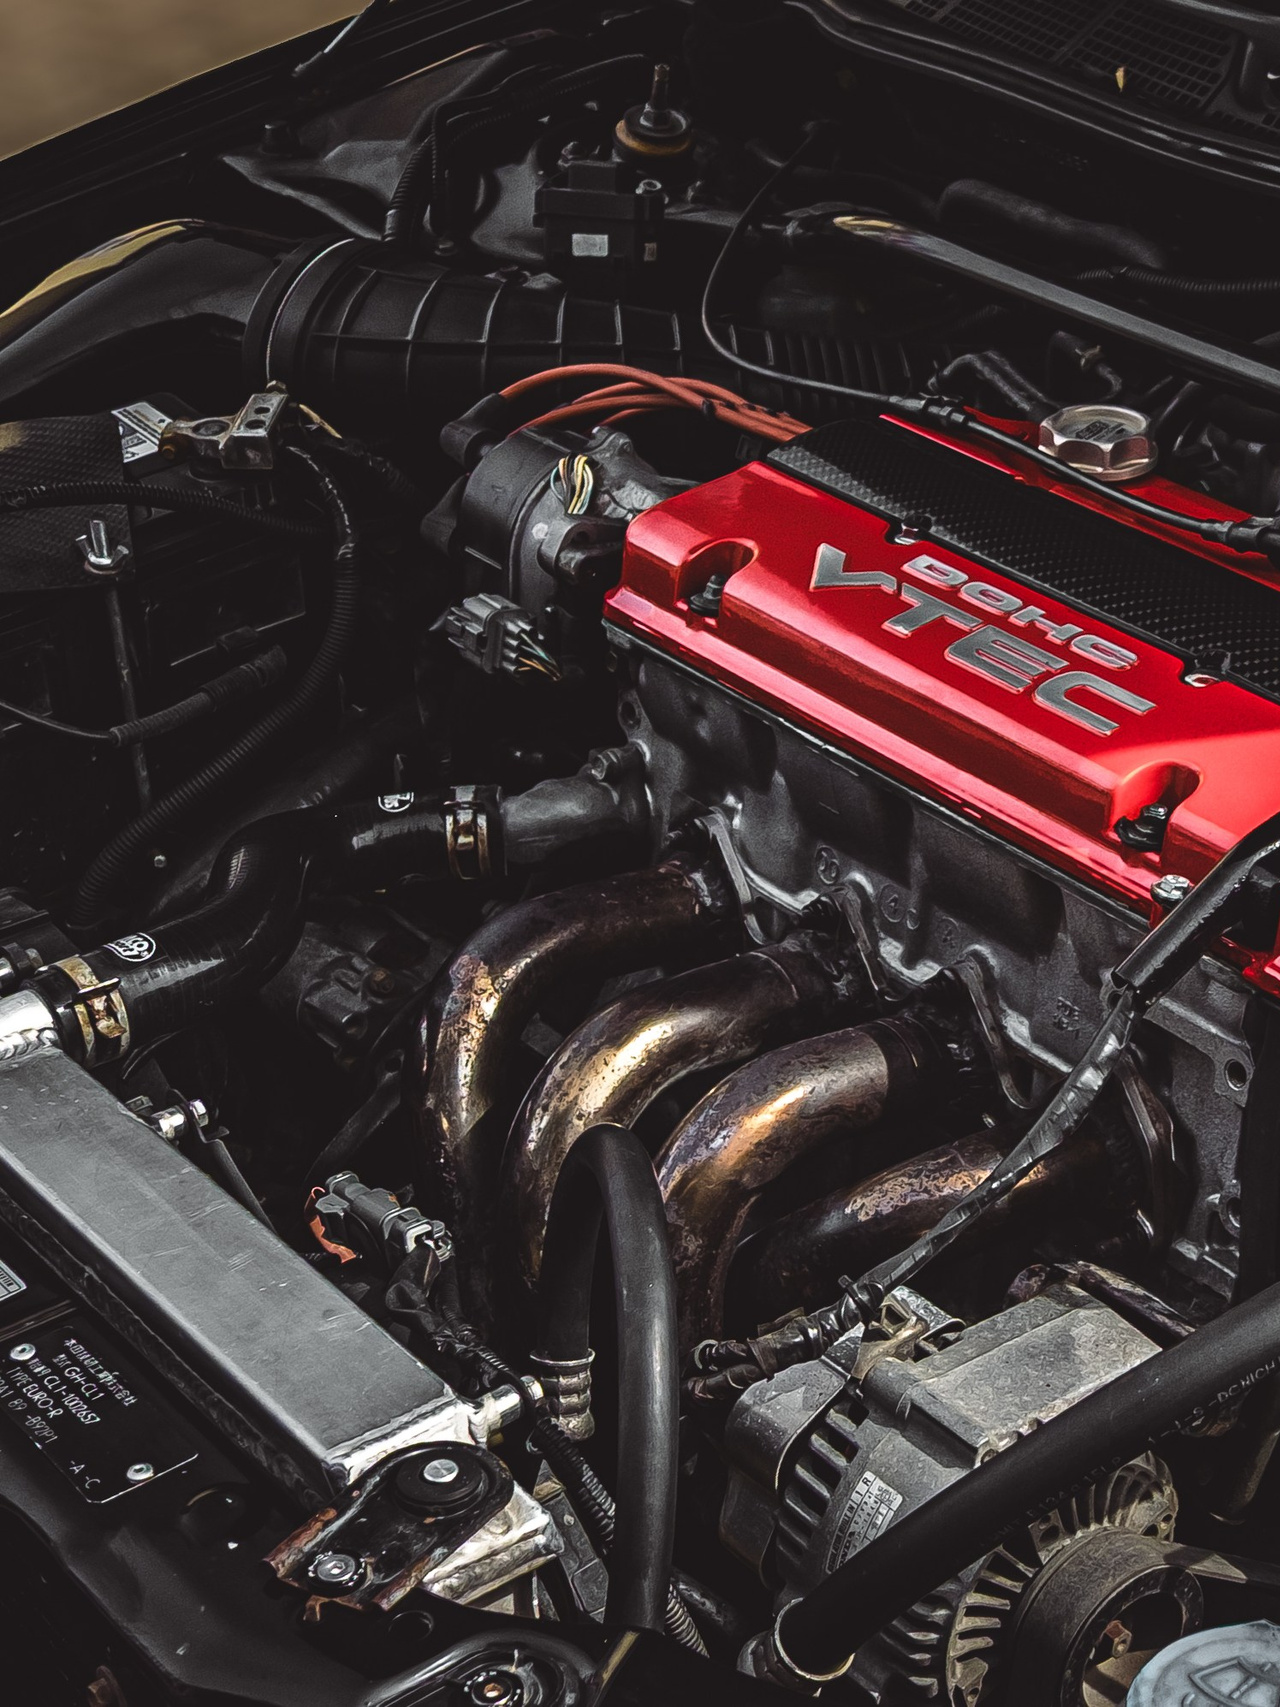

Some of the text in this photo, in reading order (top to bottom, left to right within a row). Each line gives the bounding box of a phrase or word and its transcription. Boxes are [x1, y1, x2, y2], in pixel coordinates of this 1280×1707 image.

[808, 541, 1159, 738] VTEC
[901, 554, 1140, 671] DOHC
[22, 1383, 64, 1419] EURO-R
[64, 1366, 106, 1401] GH-CL1
